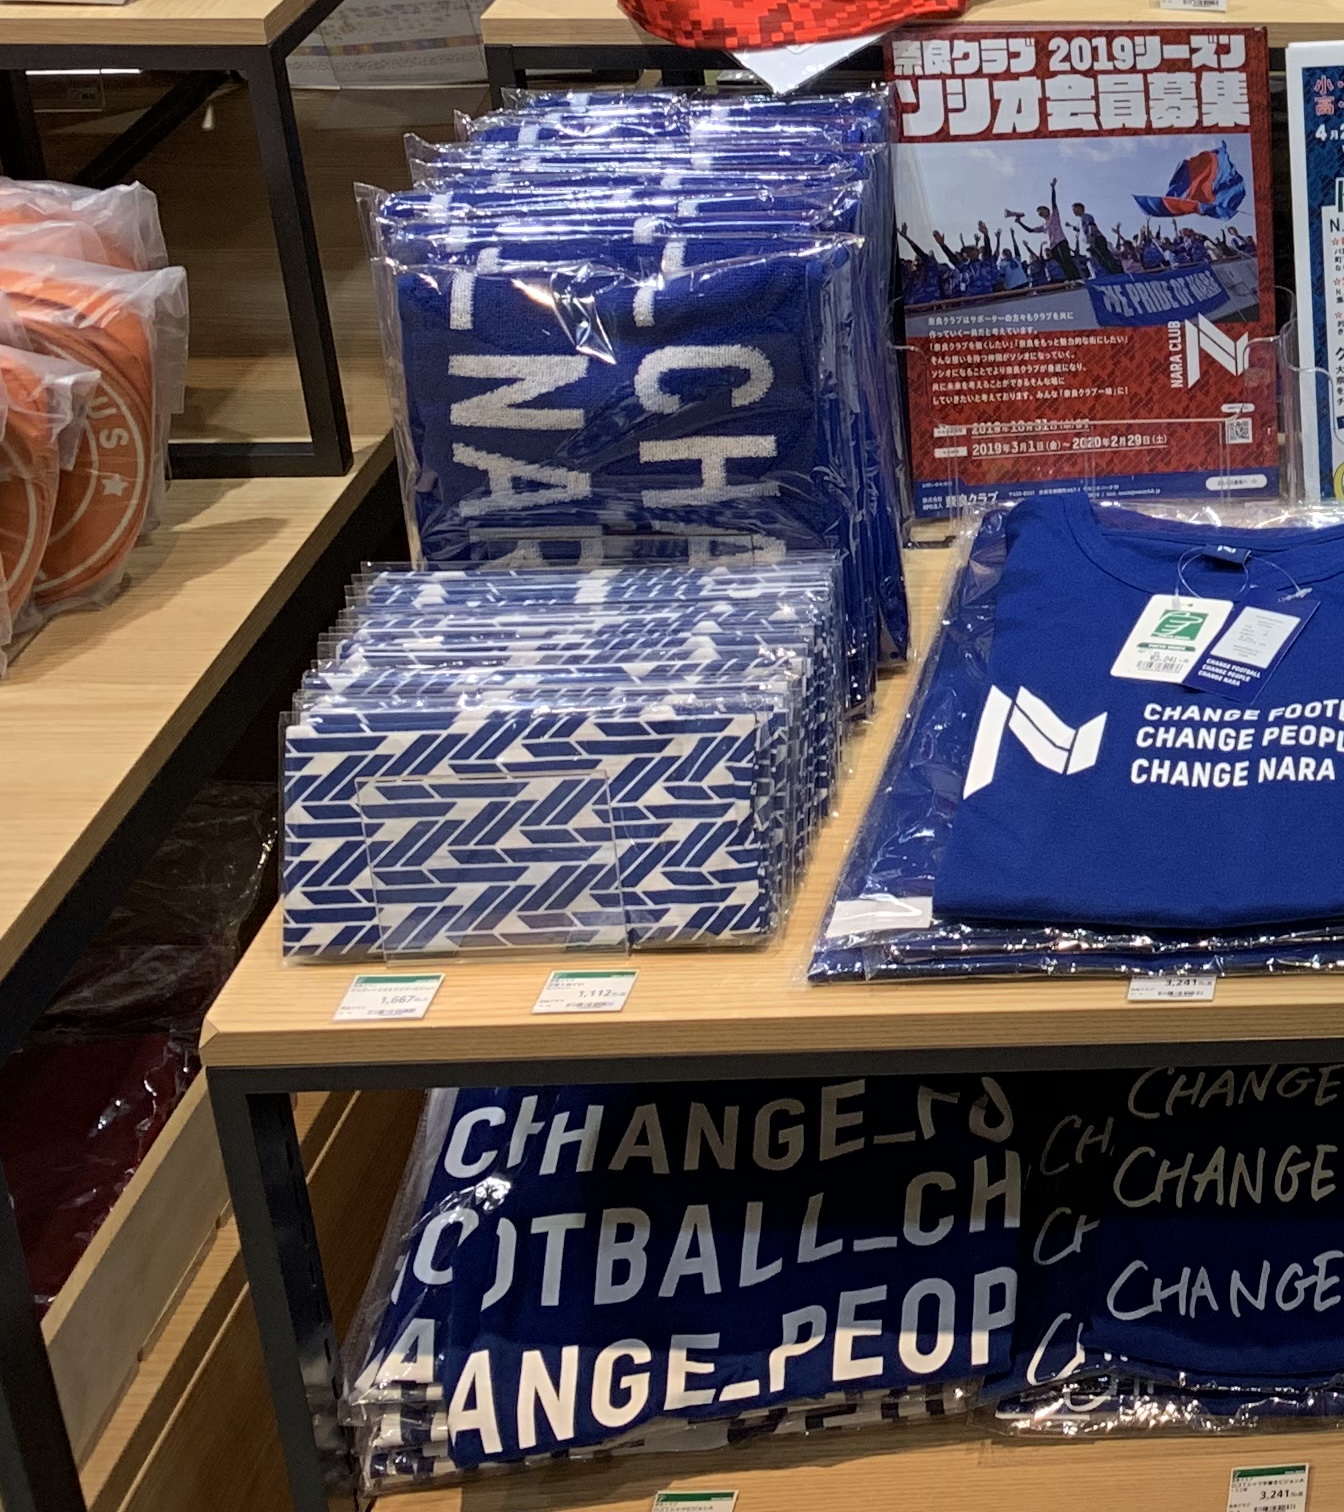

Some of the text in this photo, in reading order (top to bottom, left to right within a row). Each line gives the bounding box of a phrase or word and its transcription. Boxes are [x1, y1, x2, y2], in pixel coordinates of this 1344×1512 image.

[892, 34, 1246, 76] 奈良クラブ 2019シーズン
[899, 72, 1251, 137] ソシオ会員募集
[1128, 279, 1174, 314] PRIDE
[1167, 320, 1181, 352] CLUB
[1169, 353, 1184, 388] NARA
[1143, 702, 1261, 722] CHANGE
[1135, 725, 1254, 752] CHANGE
[1130, 755, 1337, 789] CHANGE NARA
[1113, 1144, 1338, 1209] CHANGE
[1105, 1249, 1344, 1322] CHANGE
[1260, 1490, 1290, 1500] 3,241
